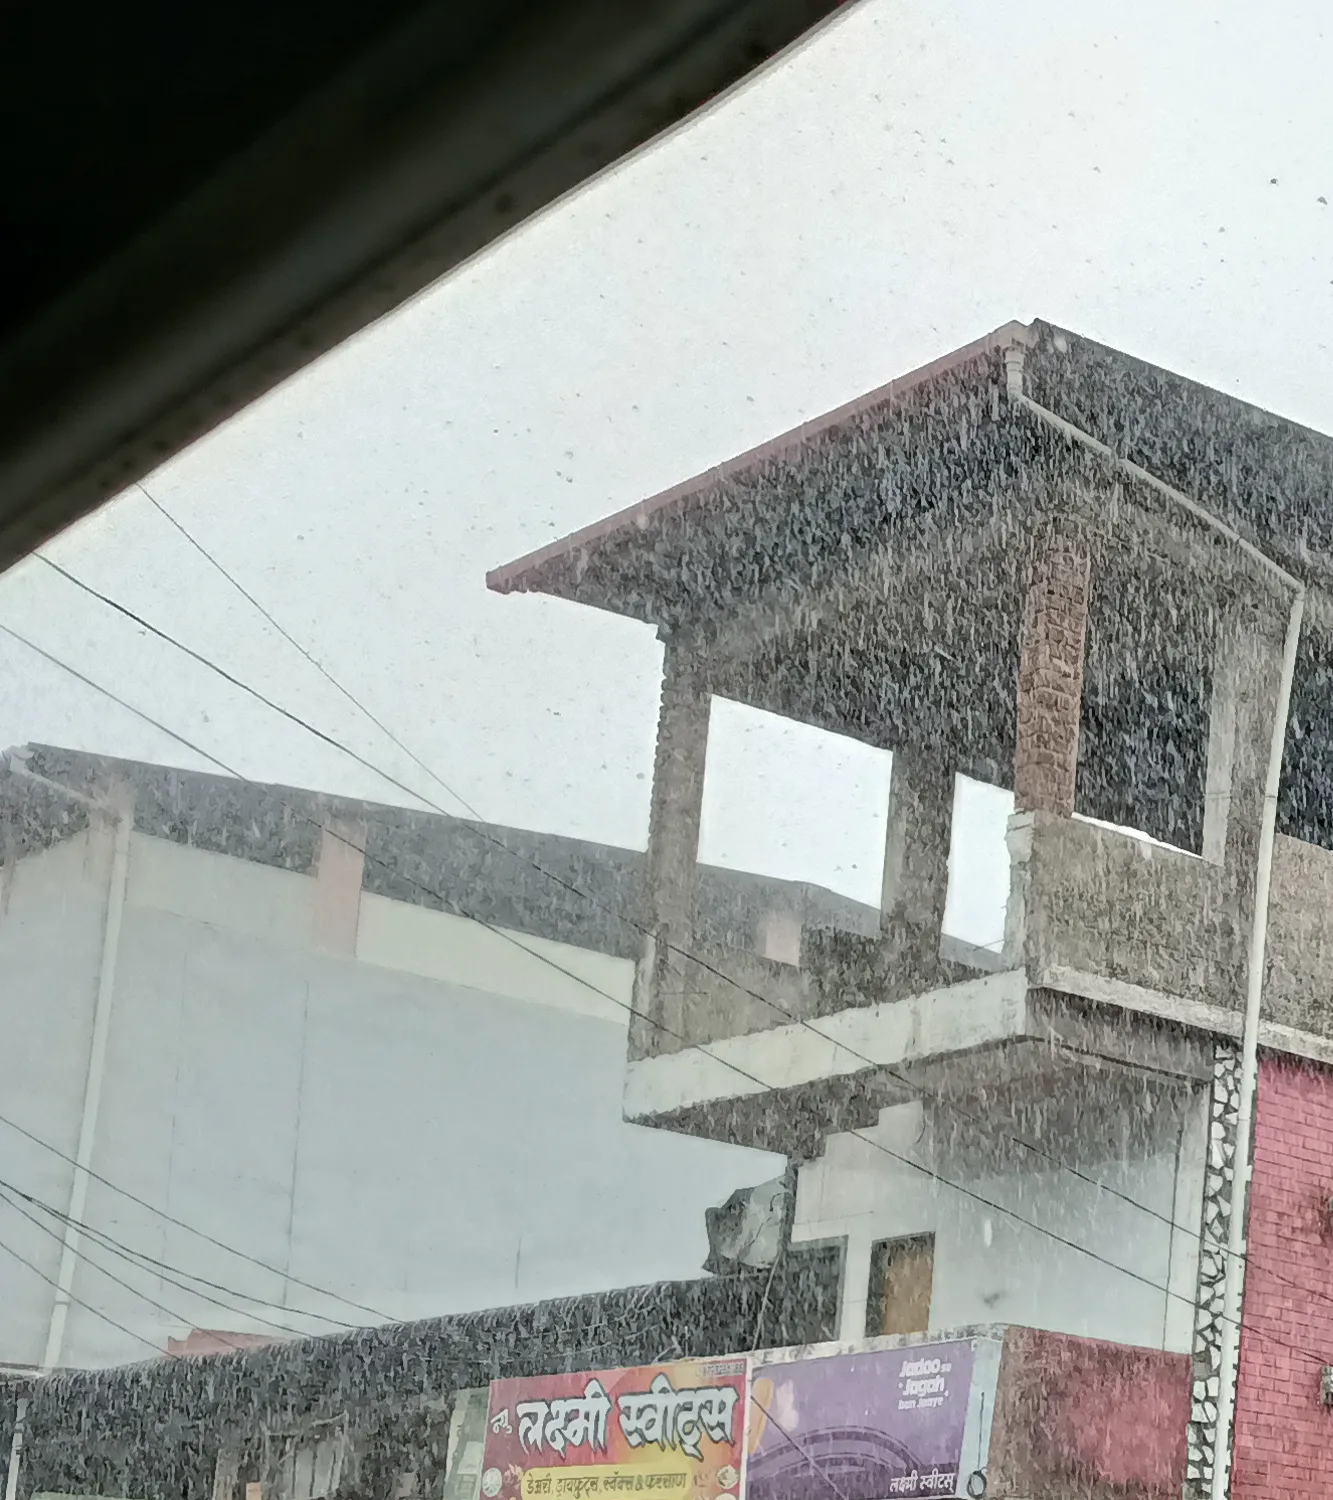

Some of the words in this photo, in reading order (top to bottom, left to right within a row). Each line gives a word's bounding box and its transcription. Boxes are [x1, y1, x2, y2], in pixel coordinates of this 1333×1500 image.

[899, 1358, 940, 1377] Jadoo
[903, 1375, 945, 1397] Jagah
[516, 1377, 611, 1461] लक्ष्मी
[617, 1372, 740, 1462] स्वीट्स
[636, 1475, 644, 1491] &
[645, 1472, 687, 1490] फरसाण
[890, 1470, 918, 1493] लक्ष्मी
